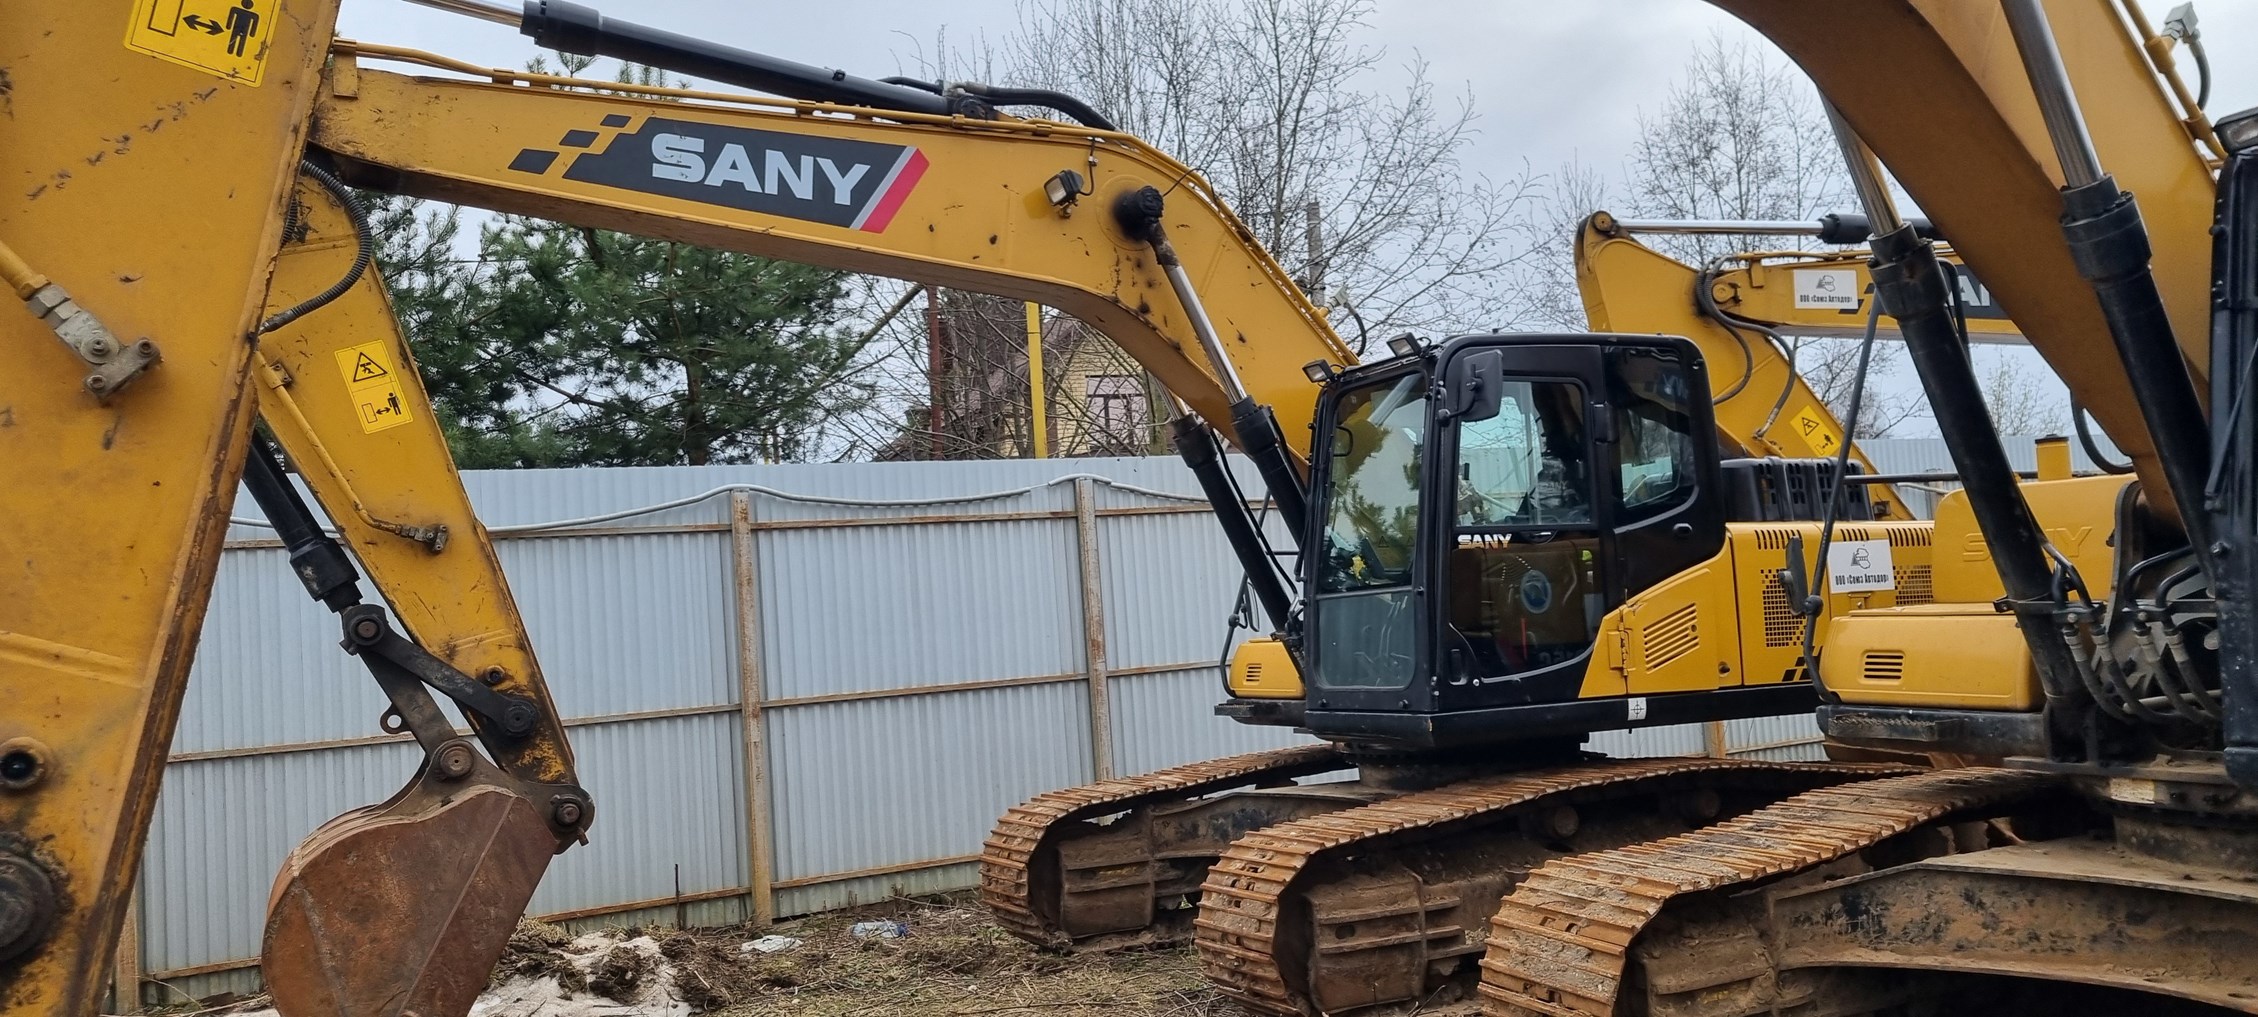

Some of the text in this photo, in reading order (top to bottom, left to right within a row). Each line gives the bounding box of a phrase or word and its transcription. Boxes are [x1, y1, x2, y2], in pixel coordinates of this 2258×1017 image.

[651, 132, 871, 206] SANY
[1457, 533, 1512, 550] SANY
[1963, 526, 2092, 563] SY
[1835, 574, 1846, 586] ООО
